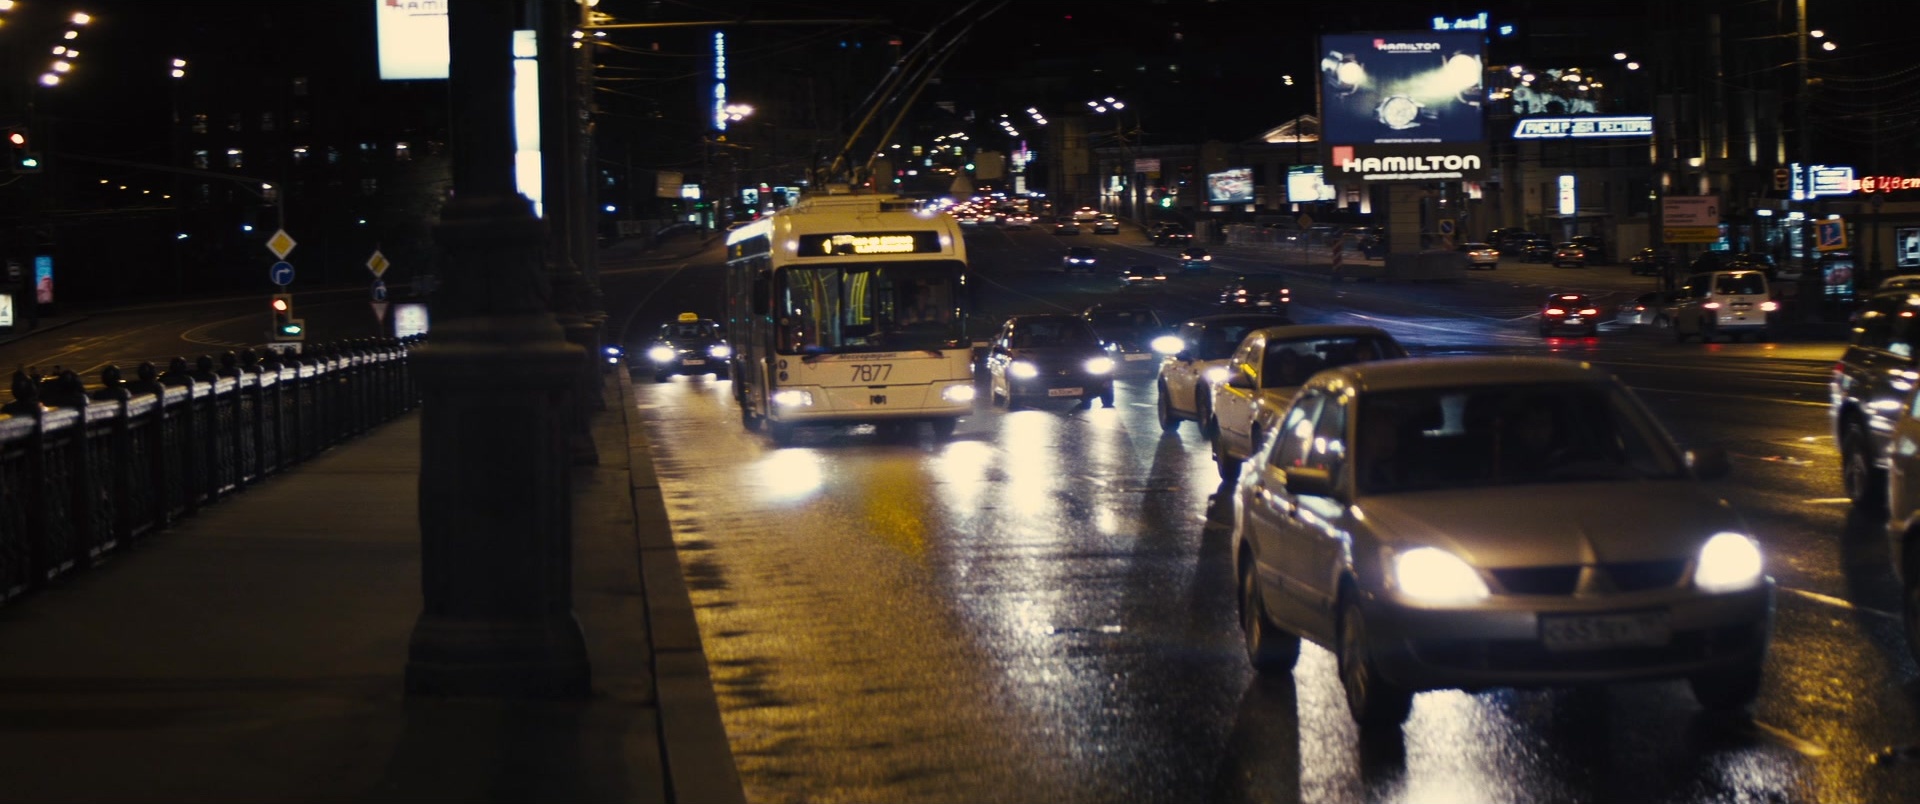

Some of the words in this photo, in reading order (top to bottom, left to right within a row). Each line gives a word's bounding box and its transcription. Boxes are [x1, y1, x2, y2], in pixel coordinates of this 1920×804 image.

[1377, 43, 1440, 51] HAMILTON
[1342, 154, 1481, 173] HAMILTON
[850, 364, 893, 382] 7877
